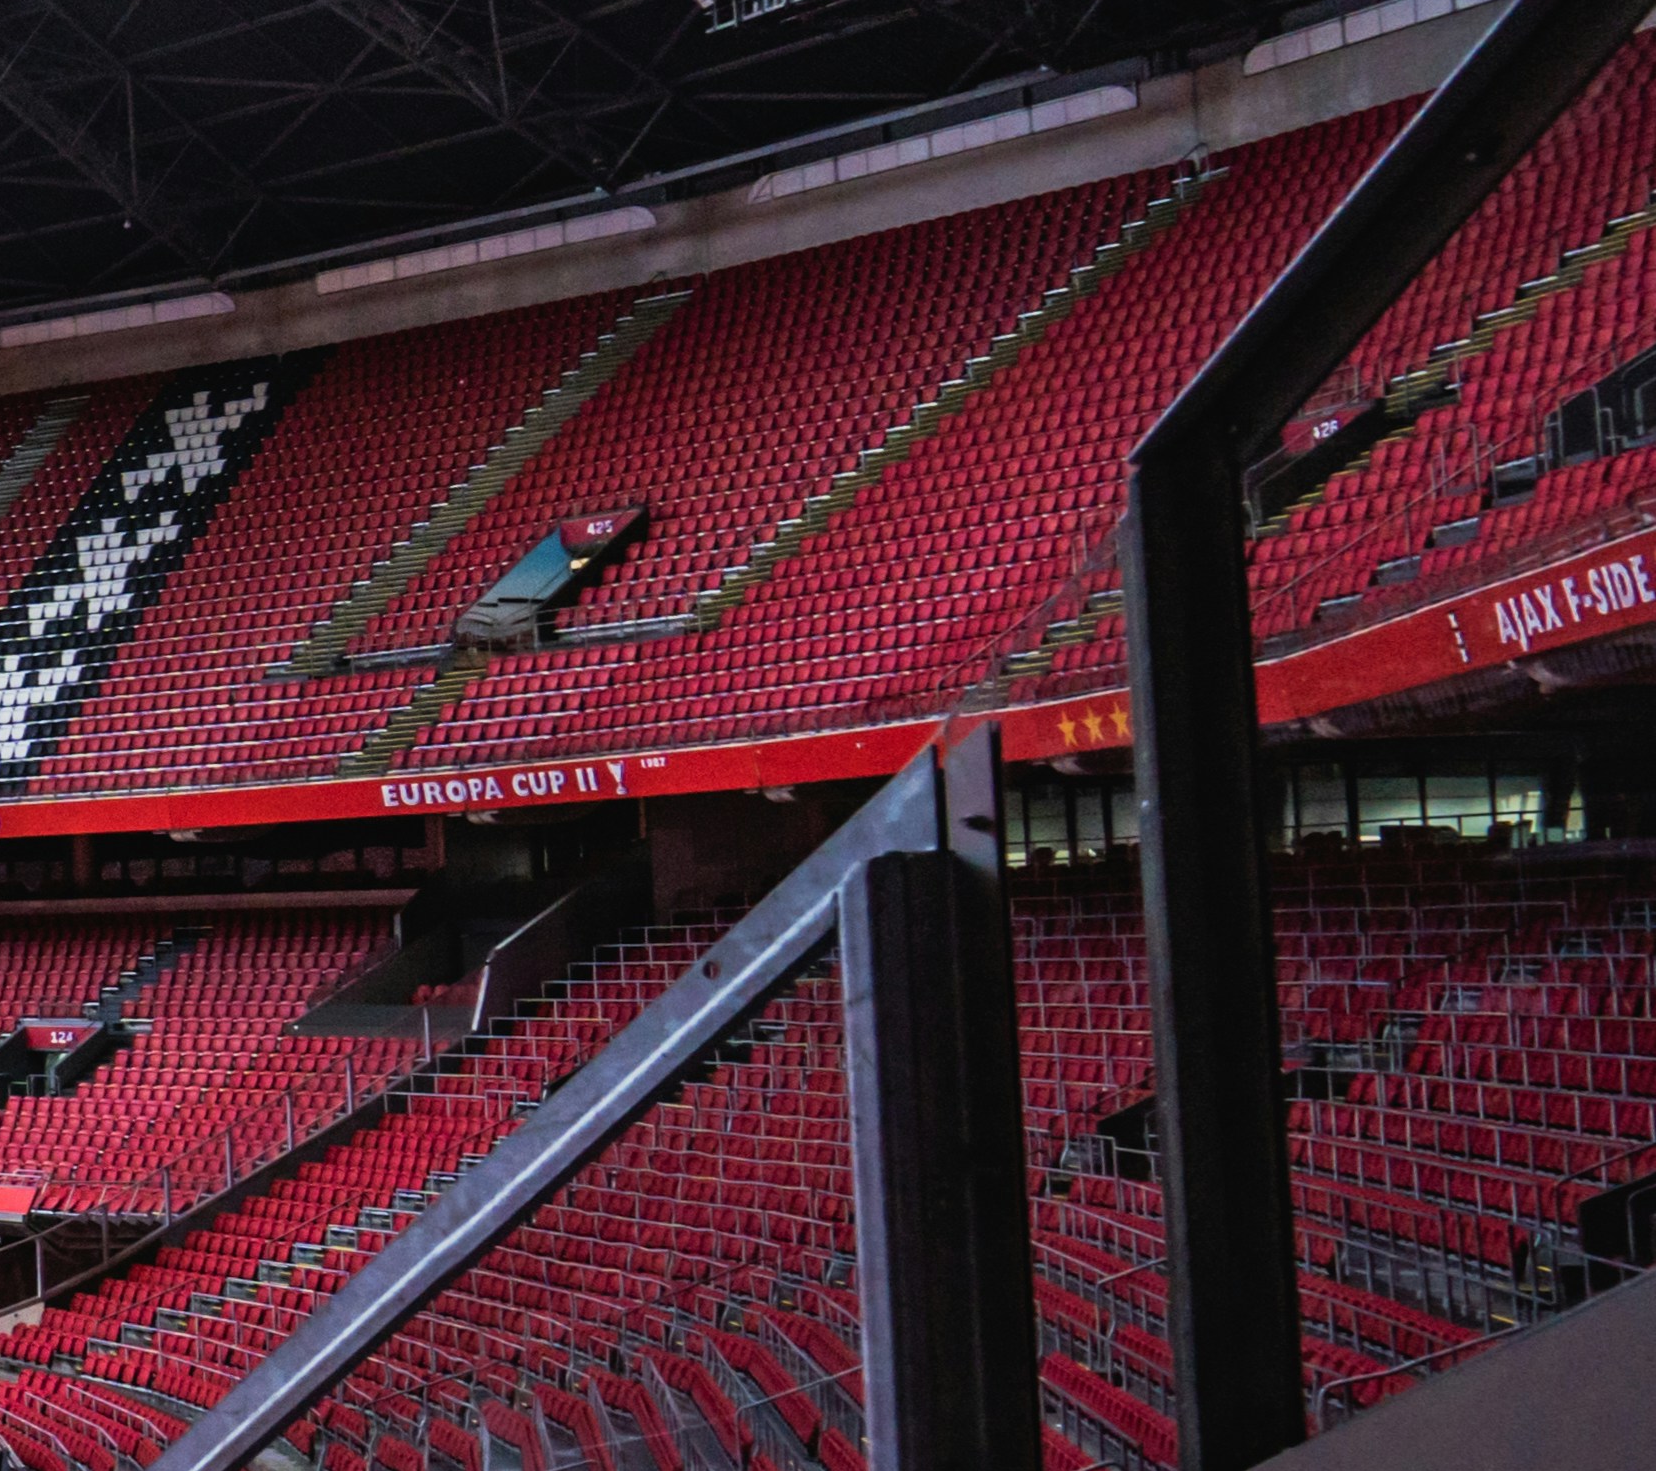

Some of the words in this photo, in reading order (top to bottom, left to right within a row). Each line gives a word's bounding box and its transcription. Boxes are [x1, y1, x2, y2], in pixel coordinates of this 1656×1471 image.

[587, 520, 613, 535] 425
[1495, 584, 1563, 652] AJAX
[1562, 555, 1655, 623] F-SIDE
[381, 776, 503, 807] EUROPA
[512, 770, 566, 797] CUP
[576, 767, 598, 792] II
[50, 1031, 74, 1043] 124
